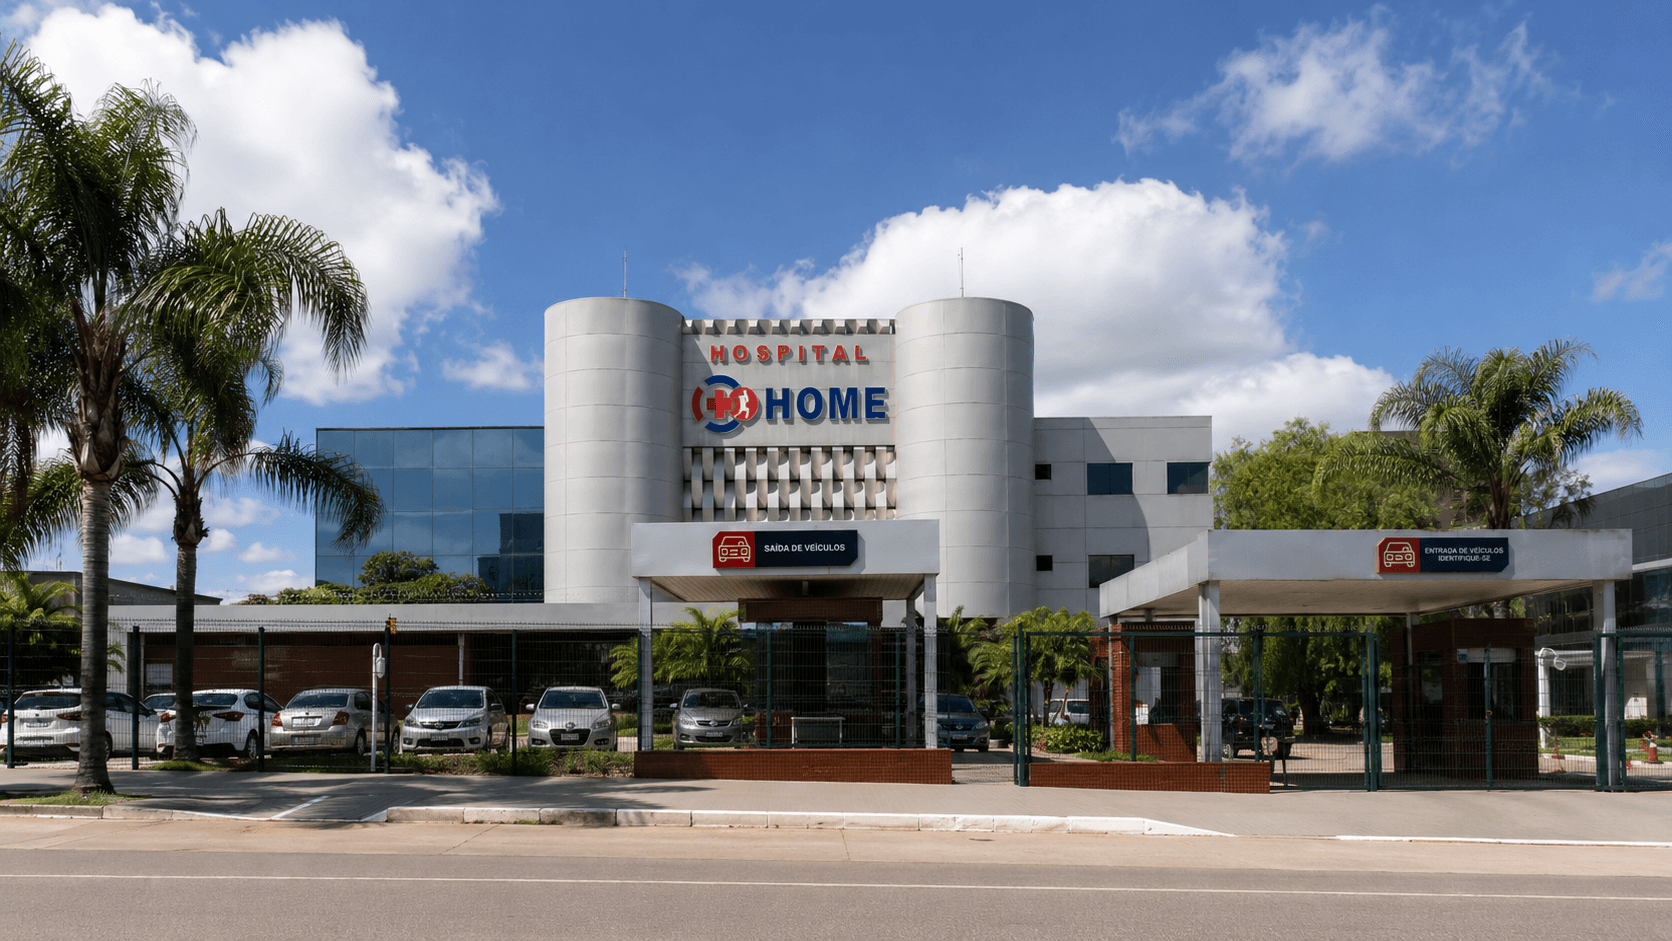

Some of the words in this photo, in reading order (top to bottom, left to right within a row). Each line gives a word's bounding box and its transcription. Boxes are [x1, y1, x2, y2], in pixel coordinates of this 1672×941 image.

[710, 345, 867, 361] HOSPITAL
[765, 387, 886, 420] HOME
[764, 542, 790, 552] SAÍDA
[791, 544, 803, 552] DE
[804, 542, 846, 552] VEÍCULOS
[1470, 546, 1504, 554] VEÍCULOS
